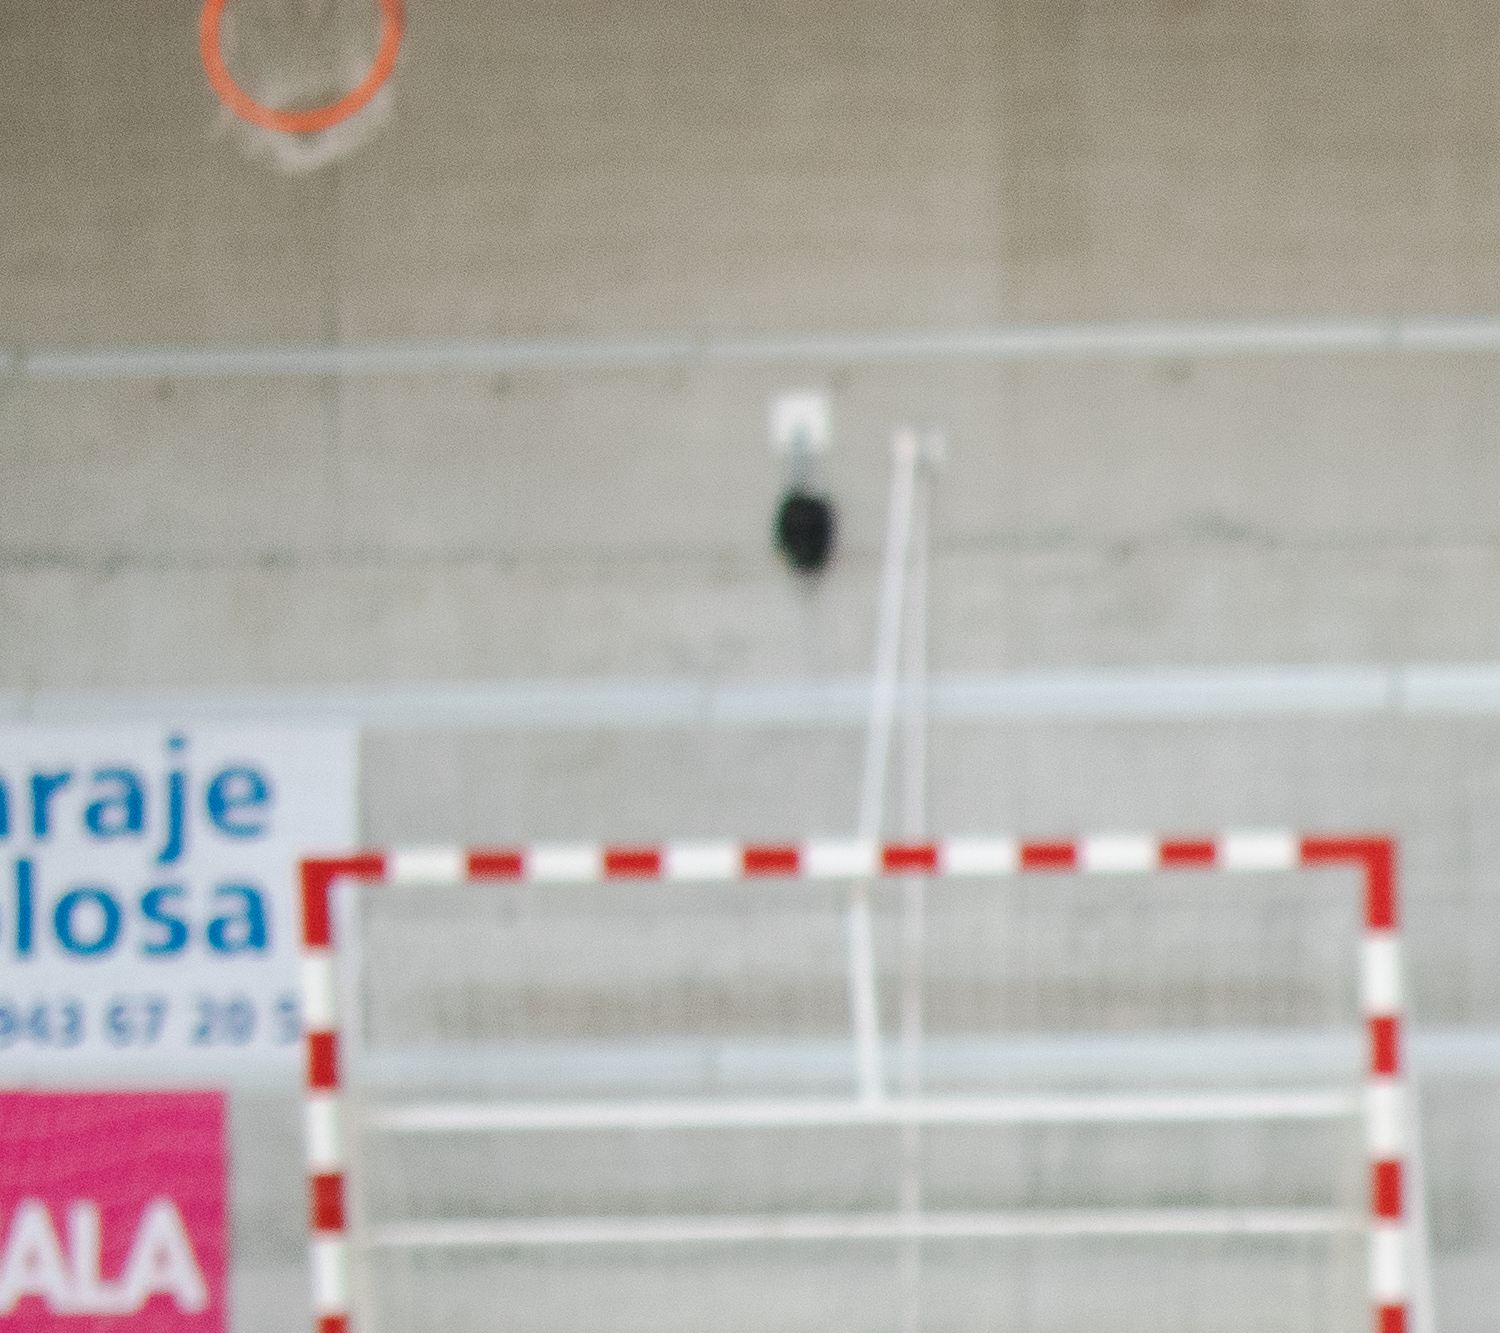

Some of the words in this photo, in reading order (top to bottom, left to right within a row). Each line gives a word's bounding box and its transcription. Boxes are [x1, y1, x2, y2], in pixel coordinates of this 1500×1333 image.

[0, 737, 268, 865] raje
[16, 858, 267, 957] losa
[0, 1199, 208, 1316] ALA
